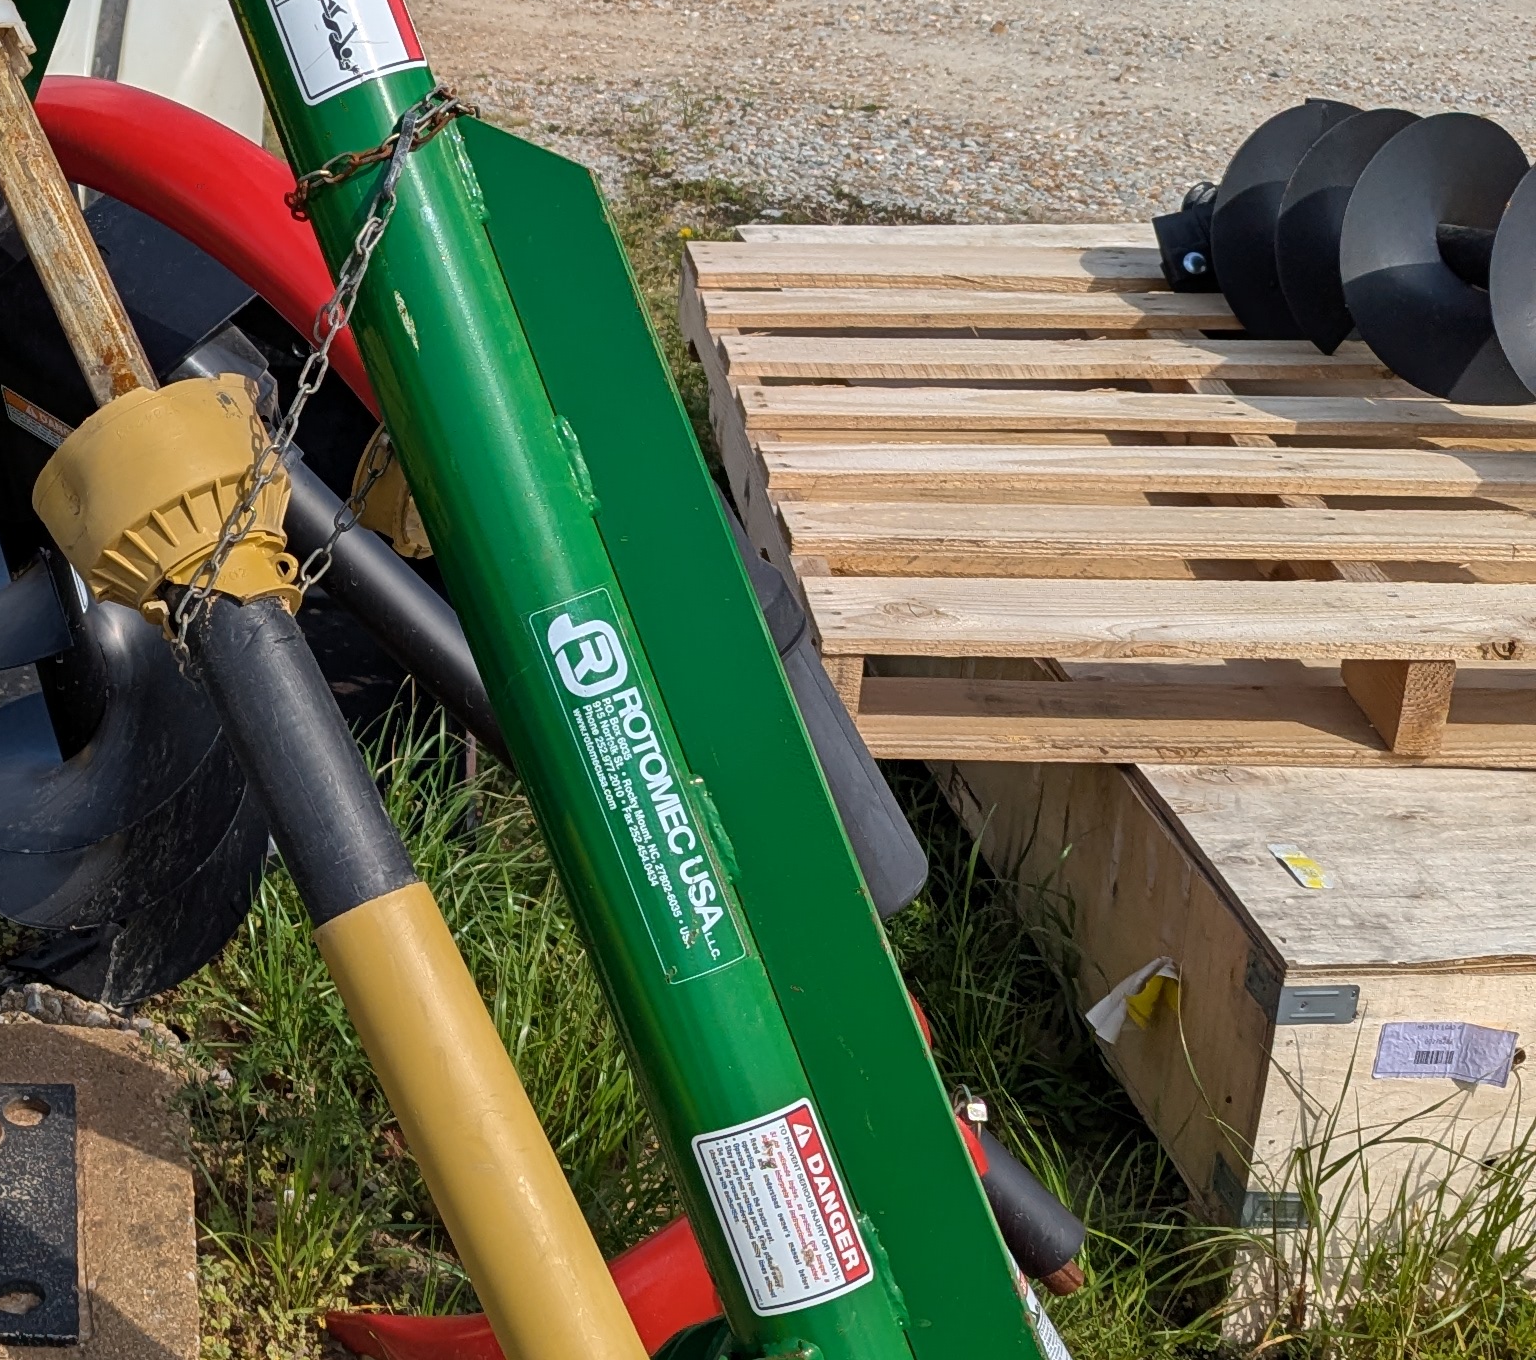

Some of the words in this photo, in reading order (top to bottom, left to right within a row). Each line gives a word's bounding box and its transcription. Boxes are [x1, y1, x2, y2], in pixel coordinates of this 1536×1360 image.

[591, 699, 606, 719] 915
[598, 718, 620, 755] Norfolk
[601, 696, 615, 716] P.O.
[608, 716, 623, 737] Box
[616, 736, 632, 761] 6035
[571, 707, 618, 811] www.rotomecusa.com
[612, 754, 625, 770] St.
[581, 703, 601, 736] Phone
[593, 735, 625, 798] 252.977.2010
[621, 806, 635, 825] Fax
[628, 824, 659, 888] 252.454.0434
[611, 685, 698, 857] ROTOMEC
[675, 854, 728, 933] USA
[619, 777, 640, 810] Rocky
[632, 808, 653, 844] Mount,
[645, 843, 661, 863] NC,
[654, 862, 683, 918] 27802-6035
[777, 1123, 787, 1135] TO
[782, 1136, 801, 1172] PREVENT
[796, 1172, 815, 1208] SERIOUS
[803, 1152, 863, 1271] DANGER
[809, 1208, 826, 1237] INJURY
[820, 1237, 831, 1251] OR
[825, 1251, 842, 1281] DEATH:
